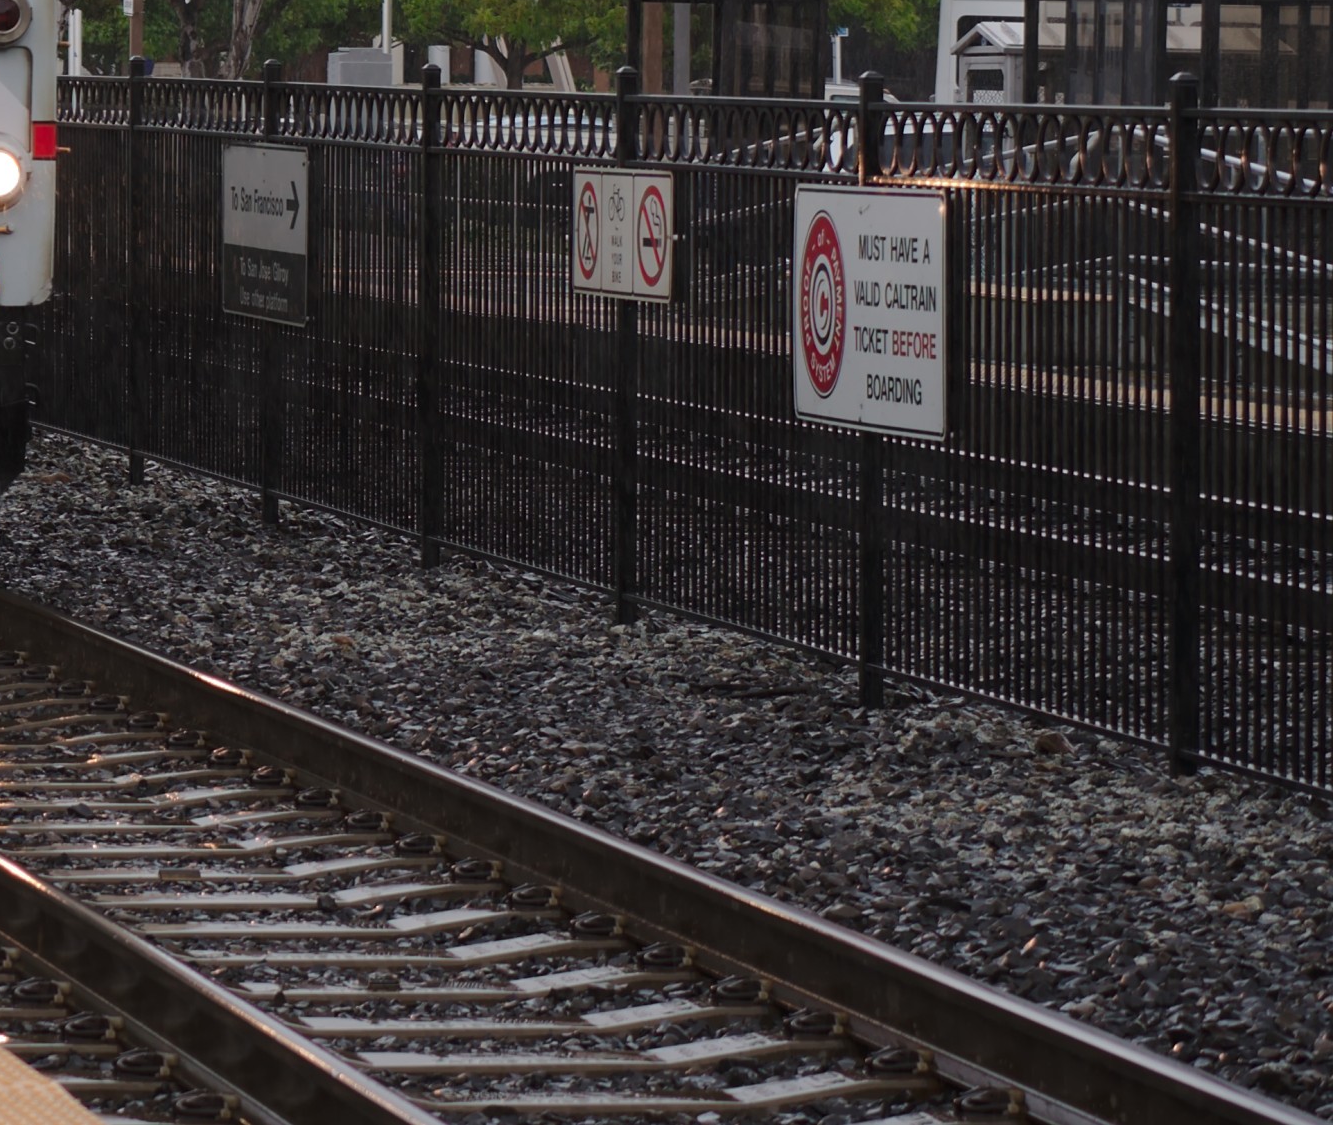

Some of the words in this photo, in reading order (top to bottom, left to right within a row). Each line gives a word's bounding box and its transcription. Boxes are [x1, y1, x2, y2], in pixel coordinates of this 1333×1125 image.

[231, 186, 239, 211] To
[240, 187, 252, 212] San
[254, 189, 284, 217] Francisco
[858, 234, 886, 261] MUST
[890, 236, 918, 264] HAVE
[922, 239, 931, 264] A
[239, 257, 246, 276] To
[247, 258, 258, 278] San
[239, 285, 250, 306] Use
[251, 289, 265, 308] other
[265, 291, 288, 313] platform
[854, 280, 880, 307] VALID
[884, 281, 936, 312] CALTRAIN
[853, 326, 888, 354] TICKET
[892, 330, 937, 359] BEFORE
[810, 351, 836, 383] SYSTEM
[866, 374, 922, 405] BOARDING
